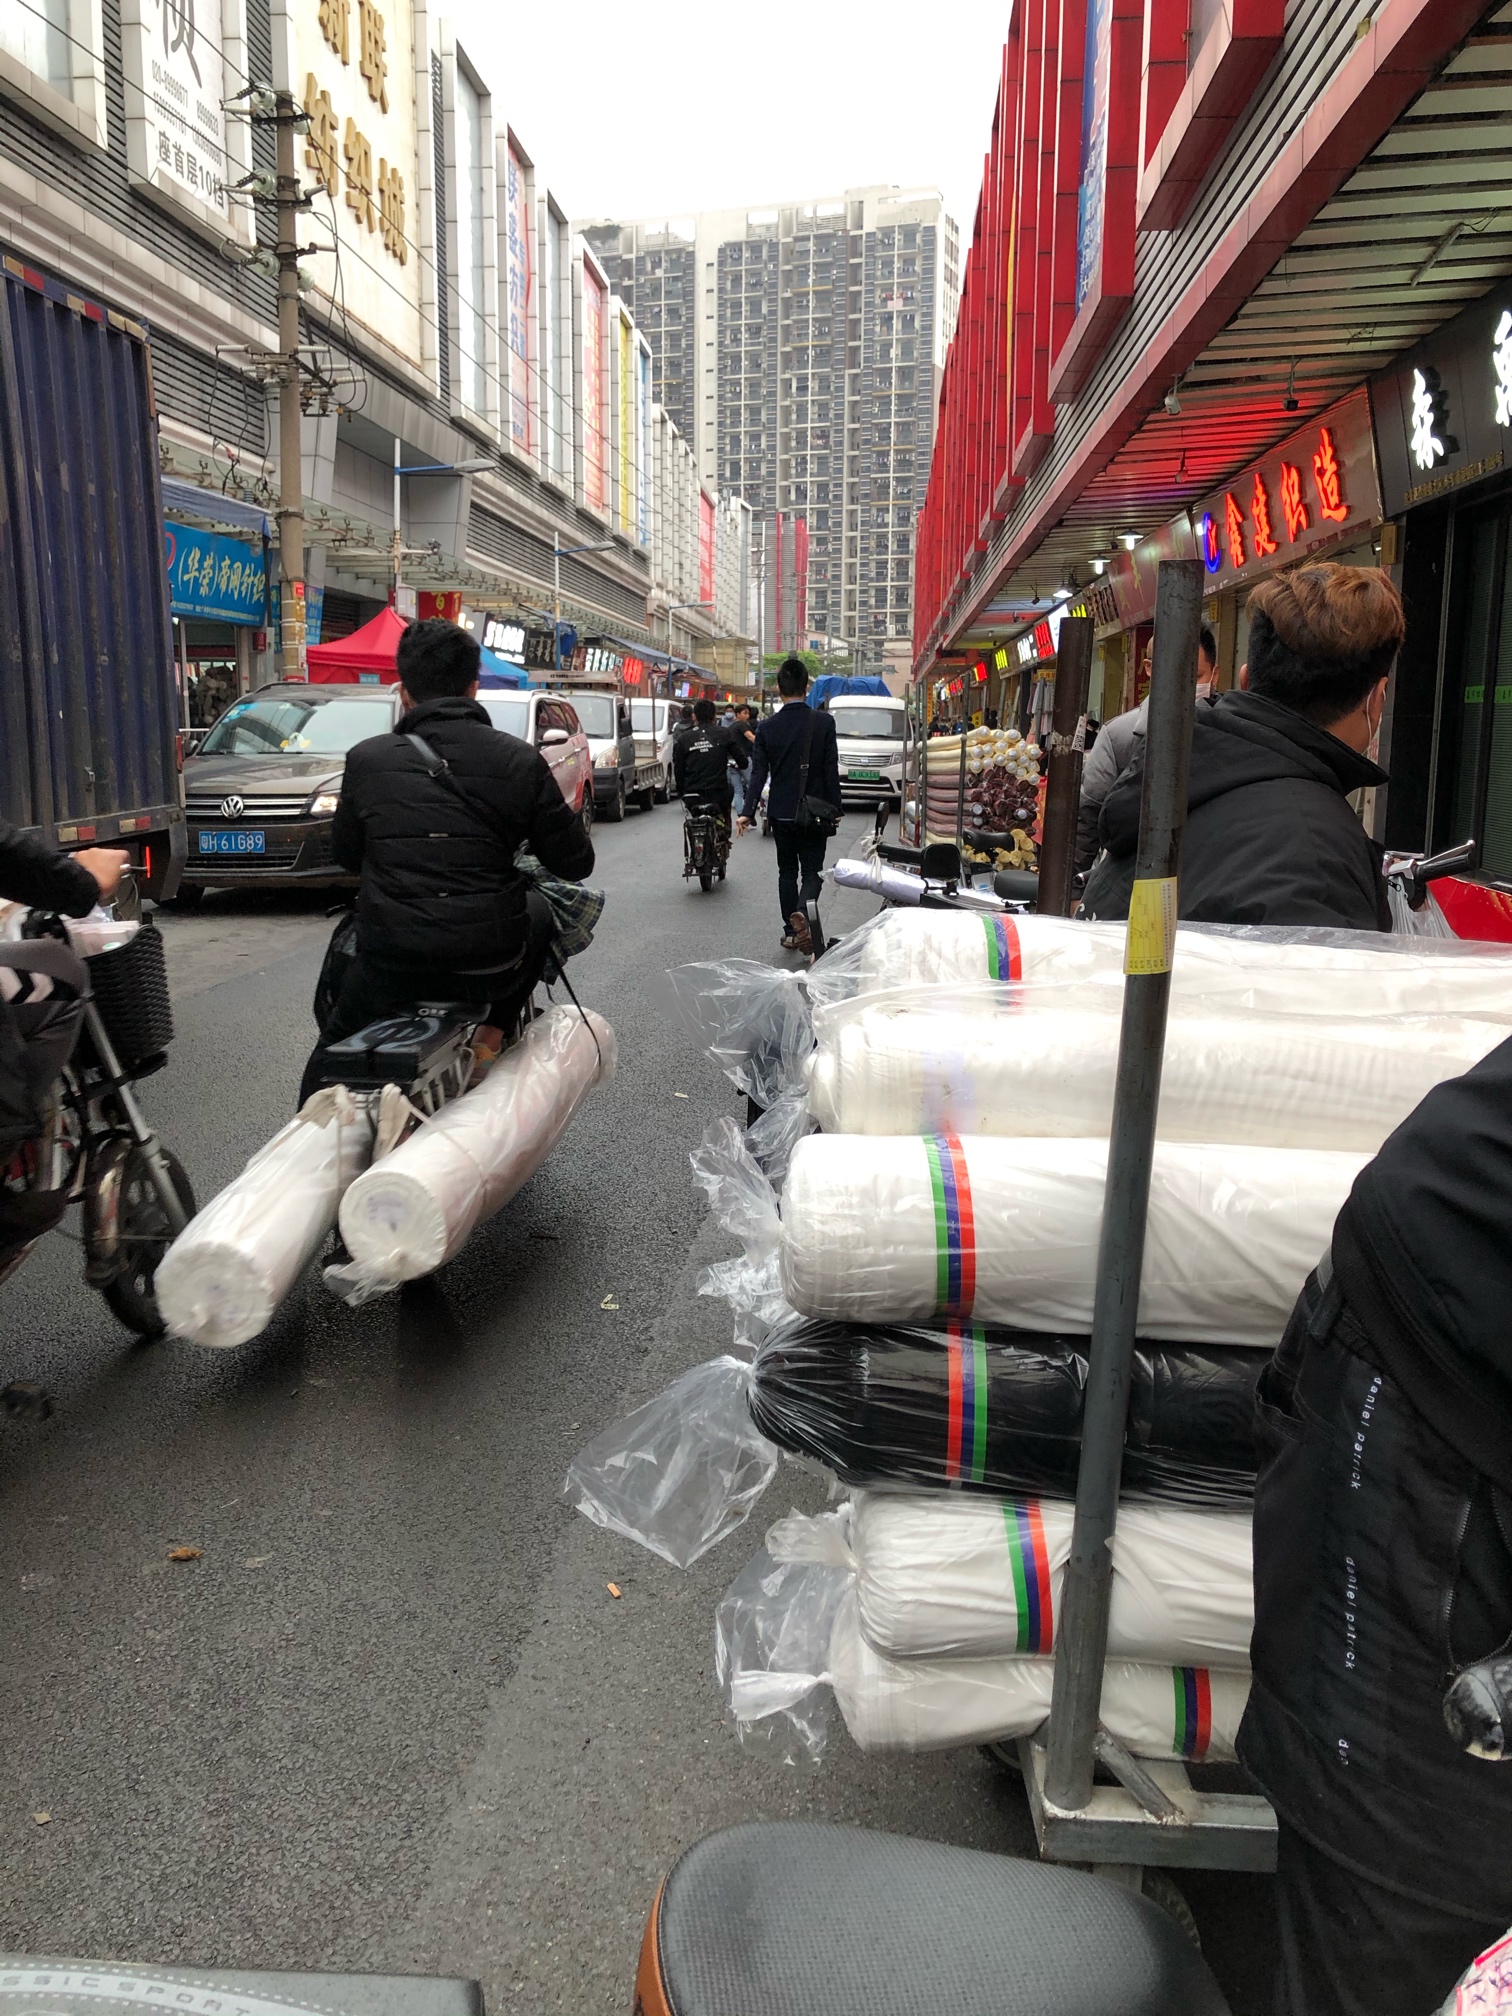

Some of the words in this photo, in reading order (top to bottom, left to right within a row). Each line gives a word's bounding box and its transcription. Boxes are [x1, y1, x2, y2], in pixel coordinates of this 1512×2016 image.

[304, 72, 408, 266] 纺织城
[1360, 1377, 1382, 1427] daniel
[1350, 1431, 1365, 1490] patrick
[1345, 1556, 1358, 1608] daniel
